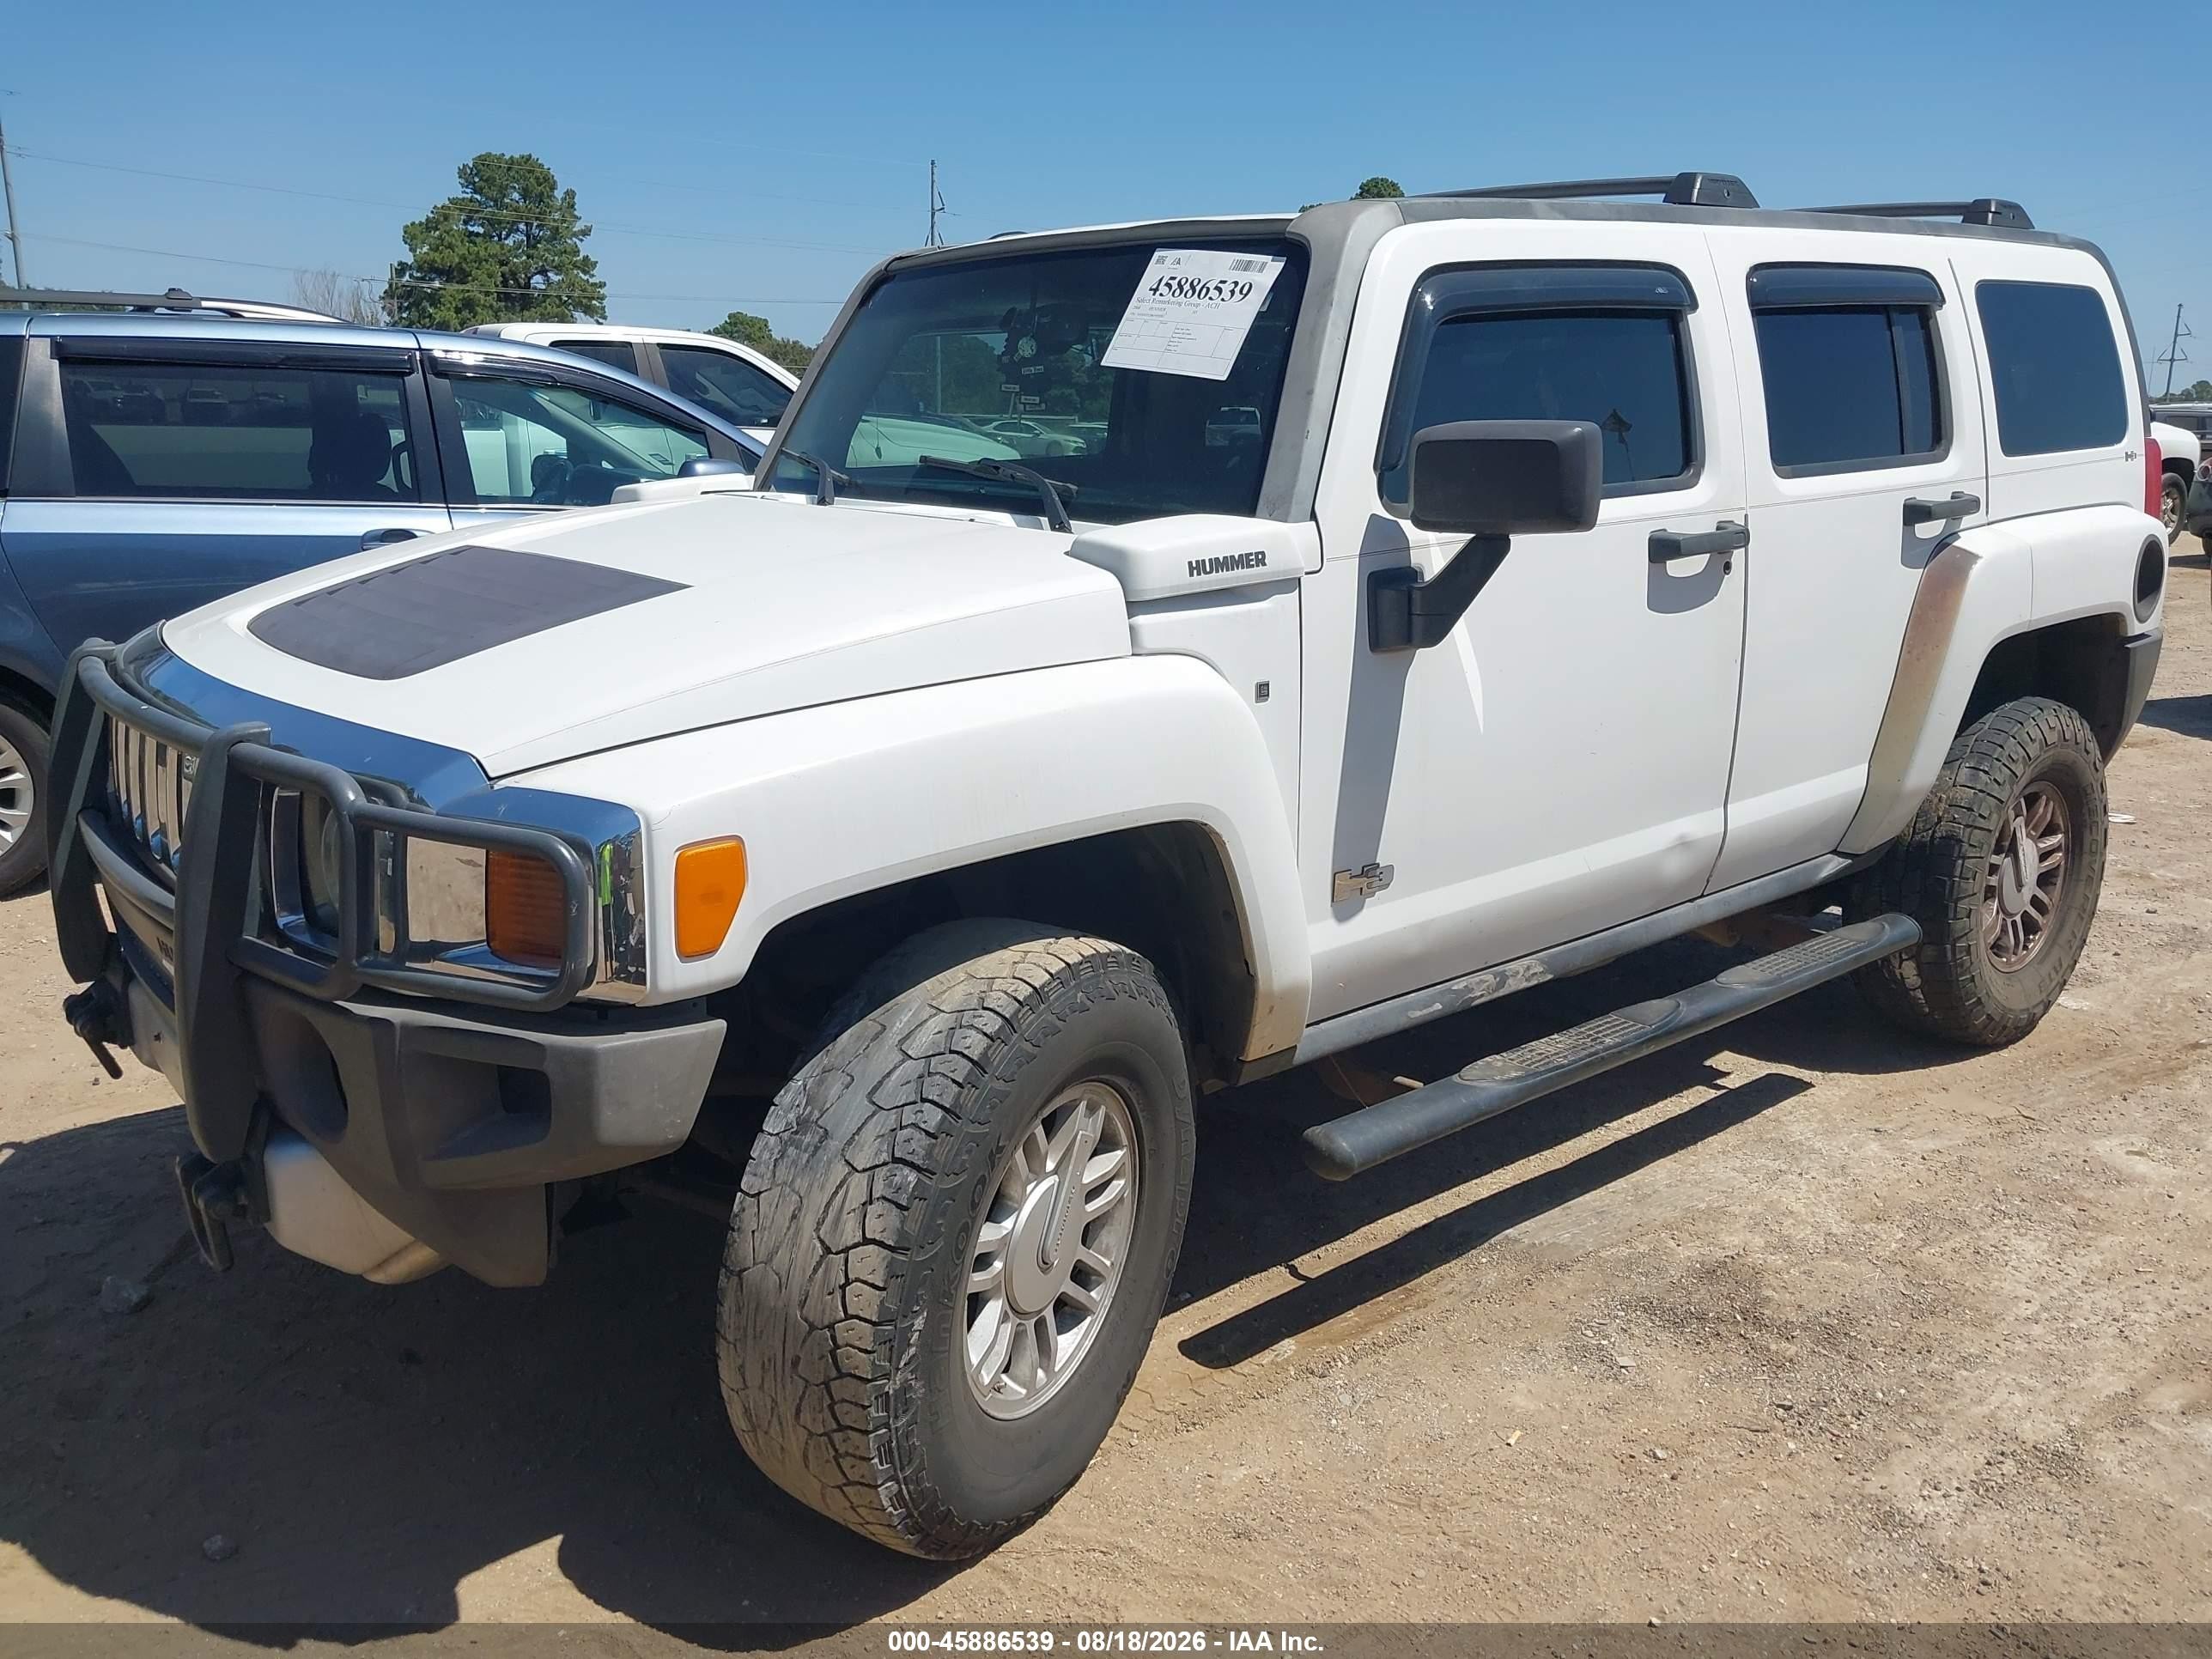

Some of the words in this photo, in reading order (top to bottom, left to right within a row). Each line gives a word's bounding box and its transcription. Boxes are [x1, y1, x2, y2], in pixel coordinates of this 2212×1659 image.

[1148, 275, 1253, 303] 45886539
[1184, 300, 1201, 309] Group
[1188, 550, 1267, 577] HUMMER
